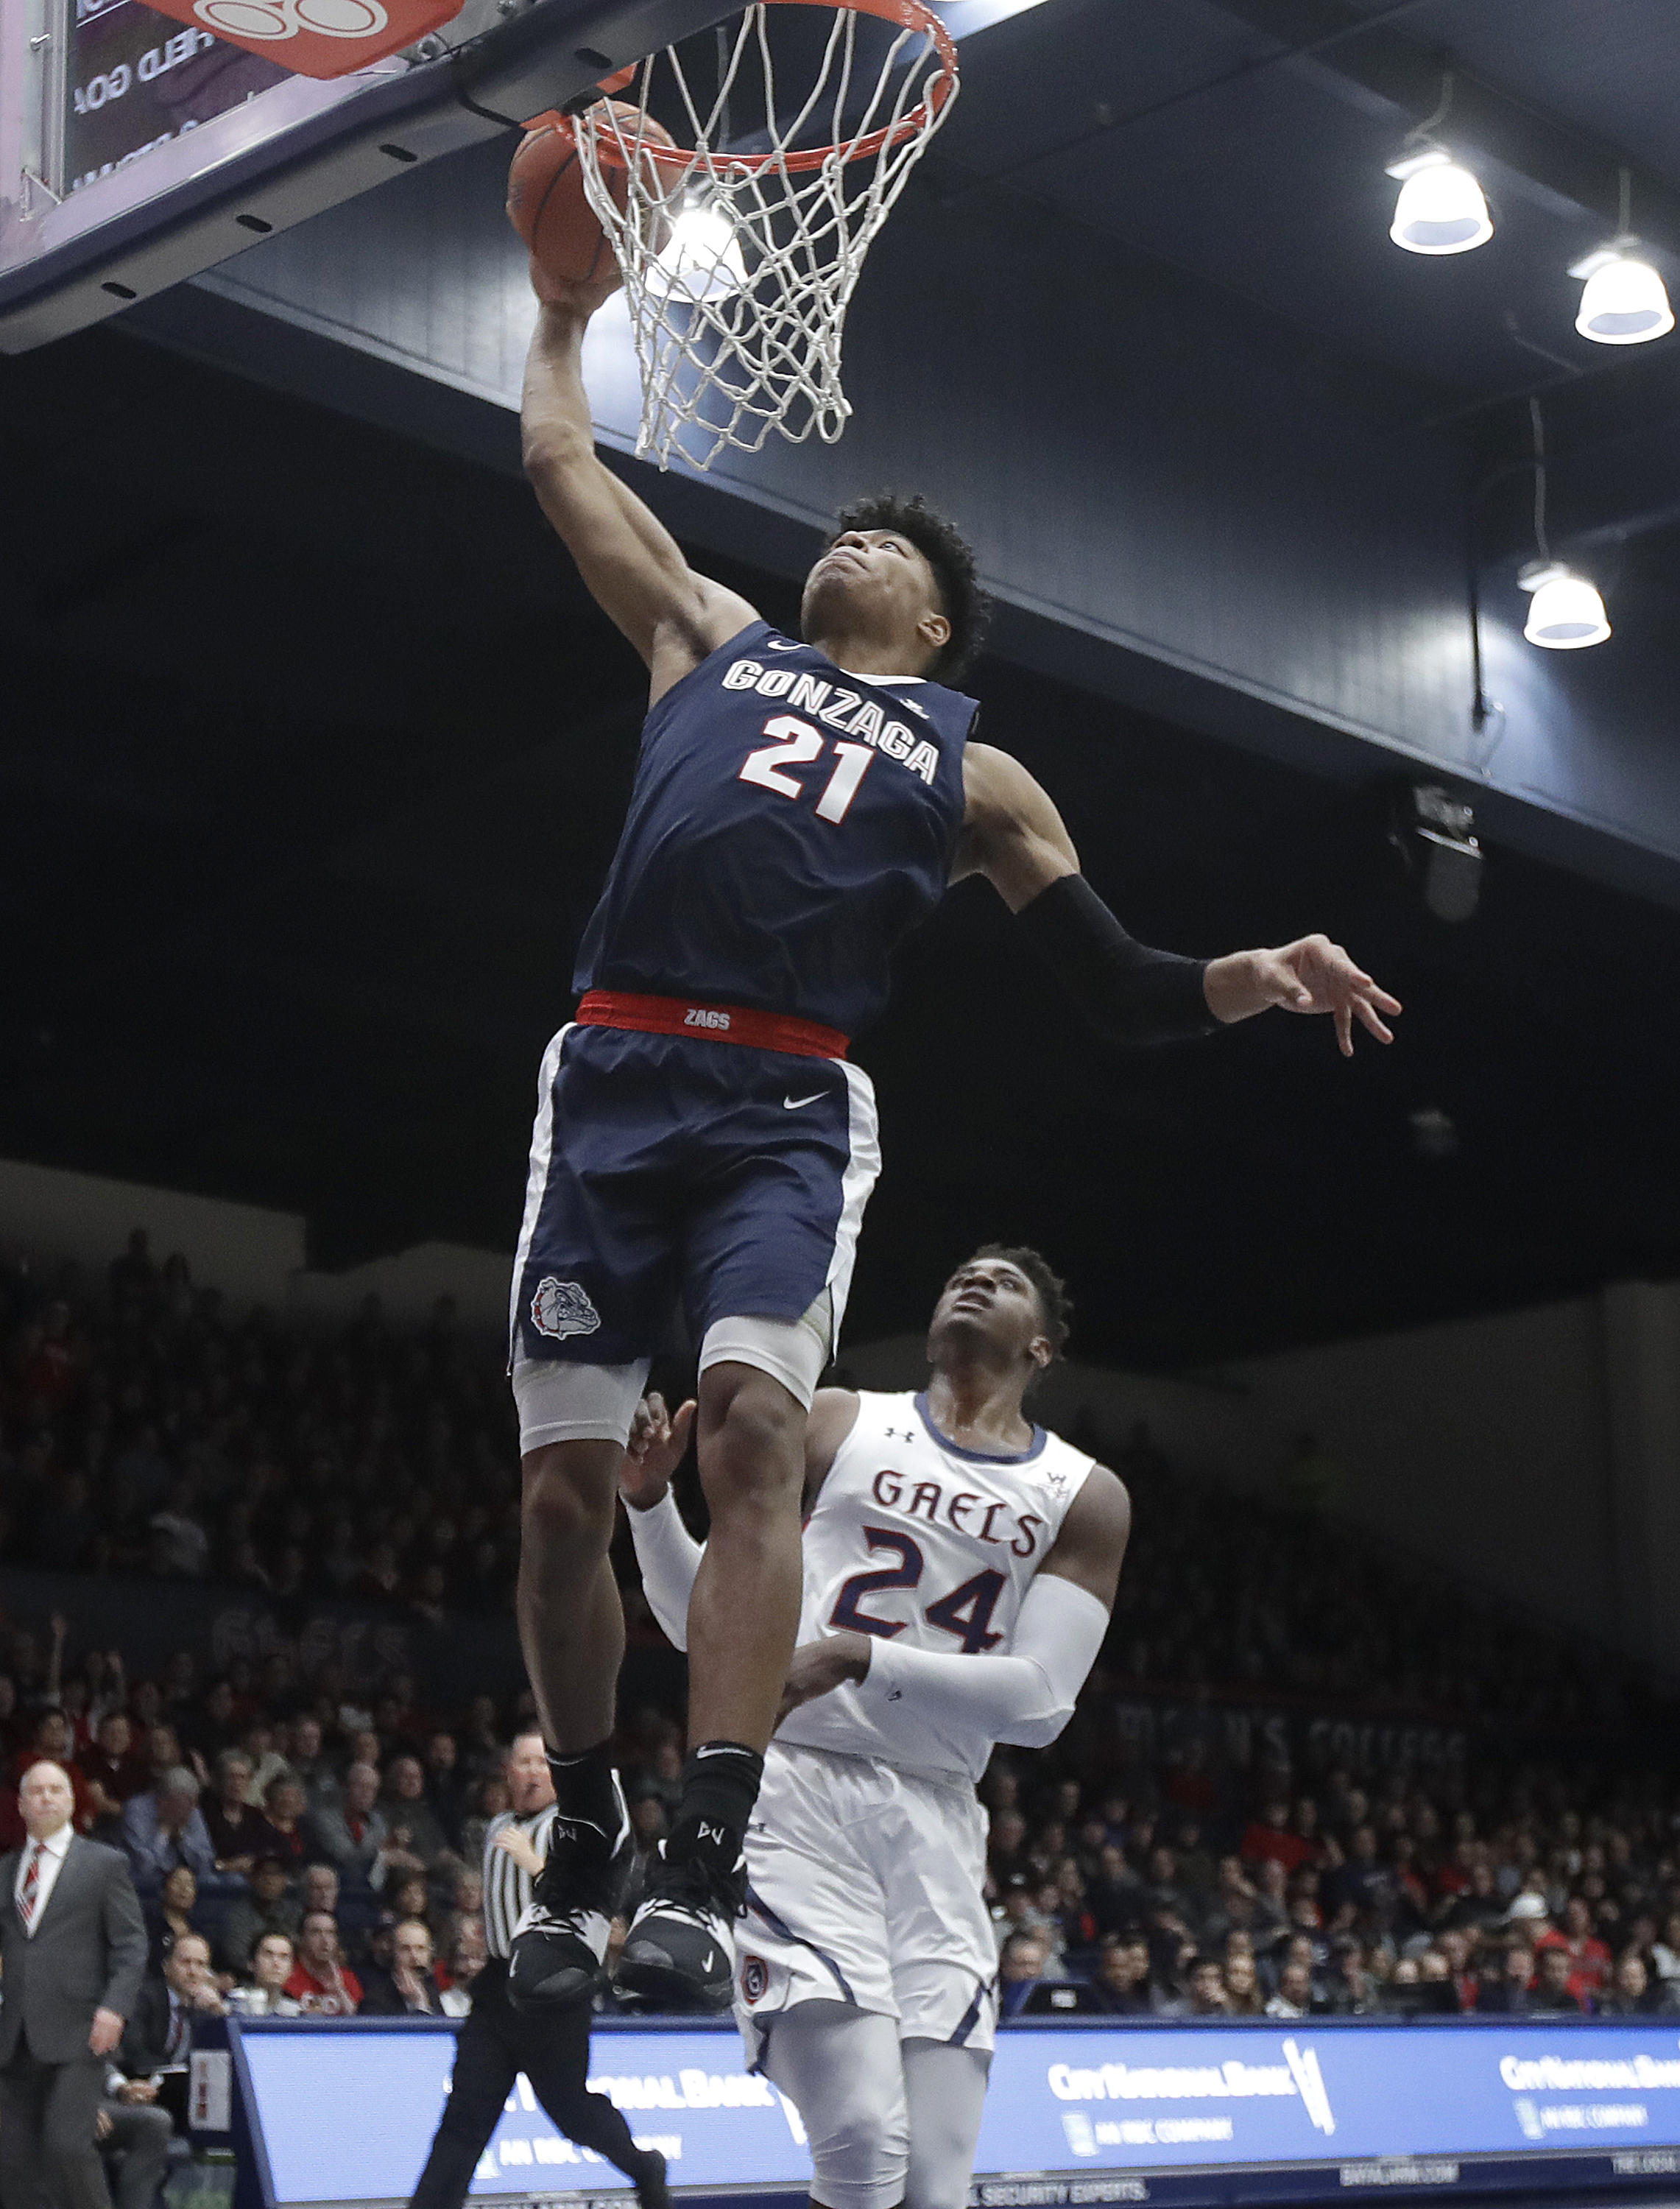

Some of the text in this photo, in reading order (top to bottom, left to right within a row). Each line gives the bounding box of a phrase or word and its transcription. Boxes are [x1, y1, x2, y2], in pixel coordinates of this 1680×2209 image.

[721, 660, 939, 786] GONZAGA
[738, 715, 876, 825] 21
[684, 1009, 730, 1030] ZAGS
[872, 1470, 1042, 1557] GAELS
[829, 1526, 1006, 1654] 24
